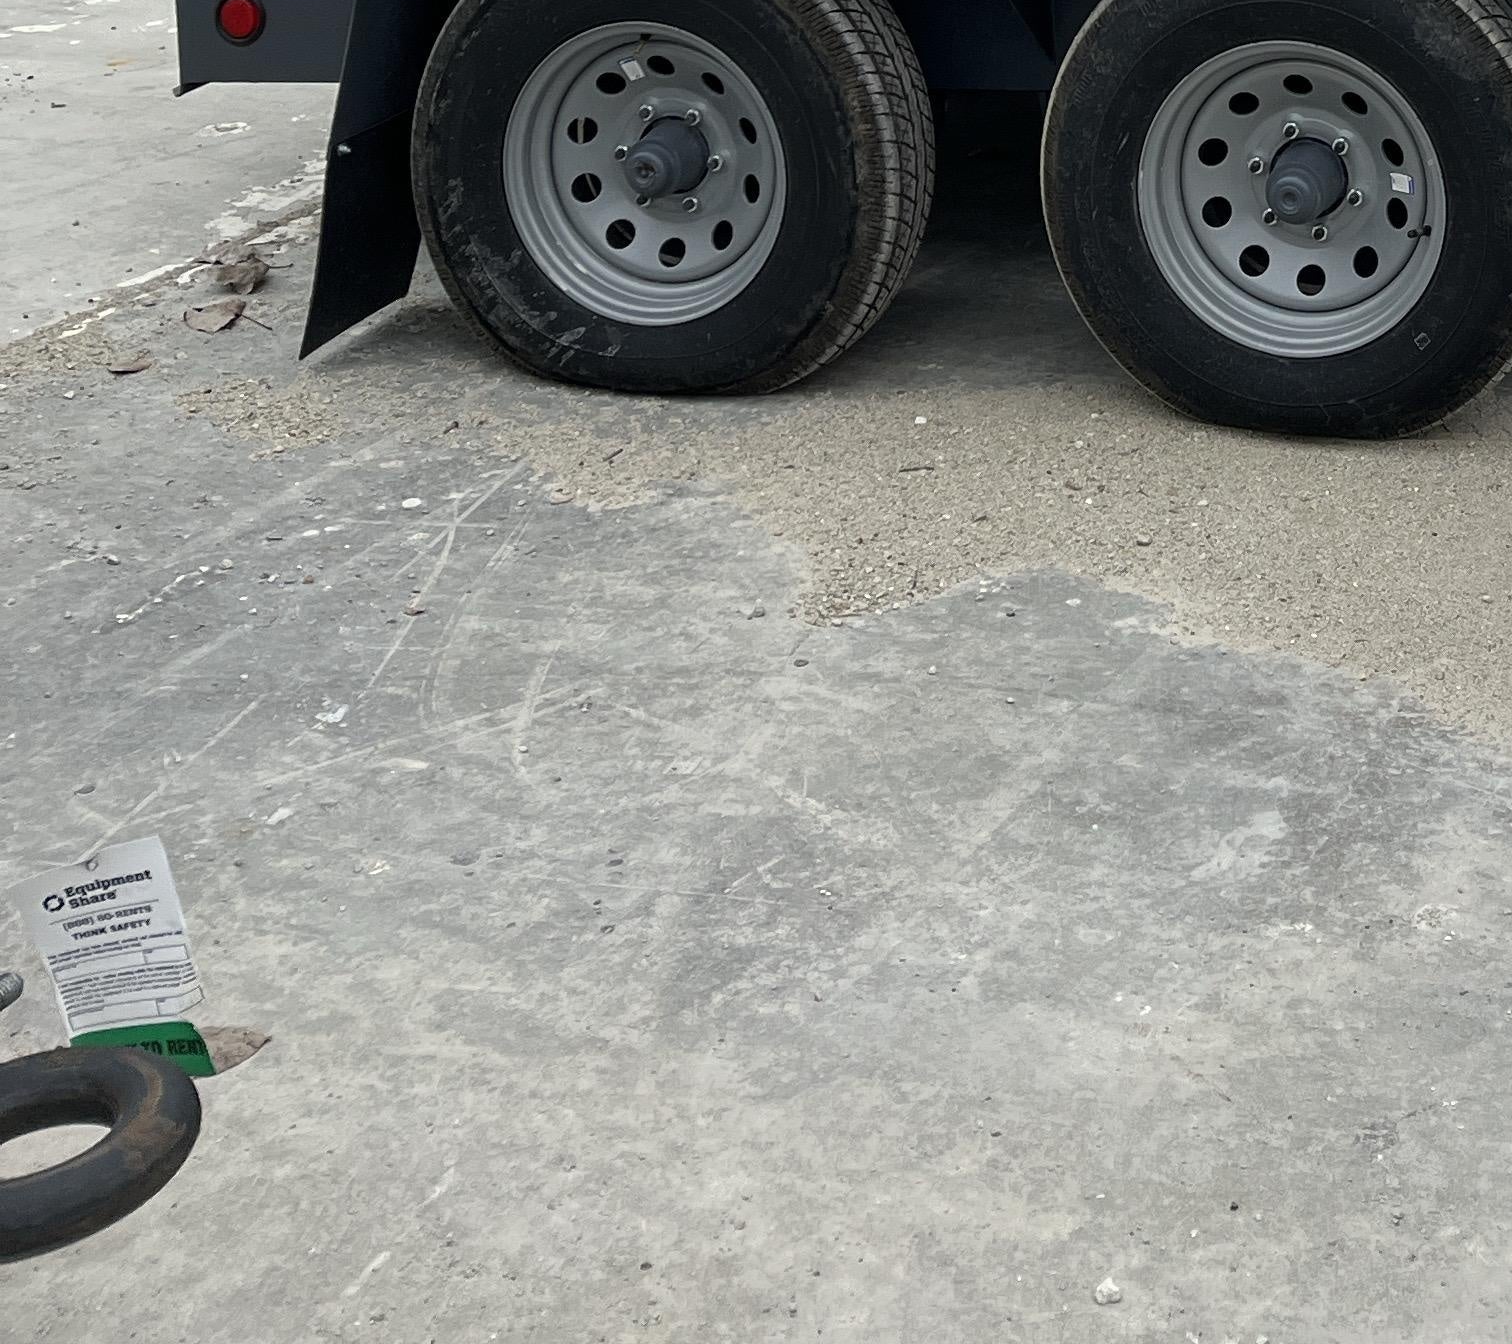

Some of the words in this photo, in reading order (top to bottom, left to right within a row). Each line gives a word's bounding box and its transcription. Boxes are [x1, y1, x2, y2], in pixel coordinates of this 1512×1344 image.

[64, 870, 153, 898] Equipment
[68, 889, 118, 909] Share
[71, 926, 107, 941] THINK
[109, 918, 151, 933] SAFETY
